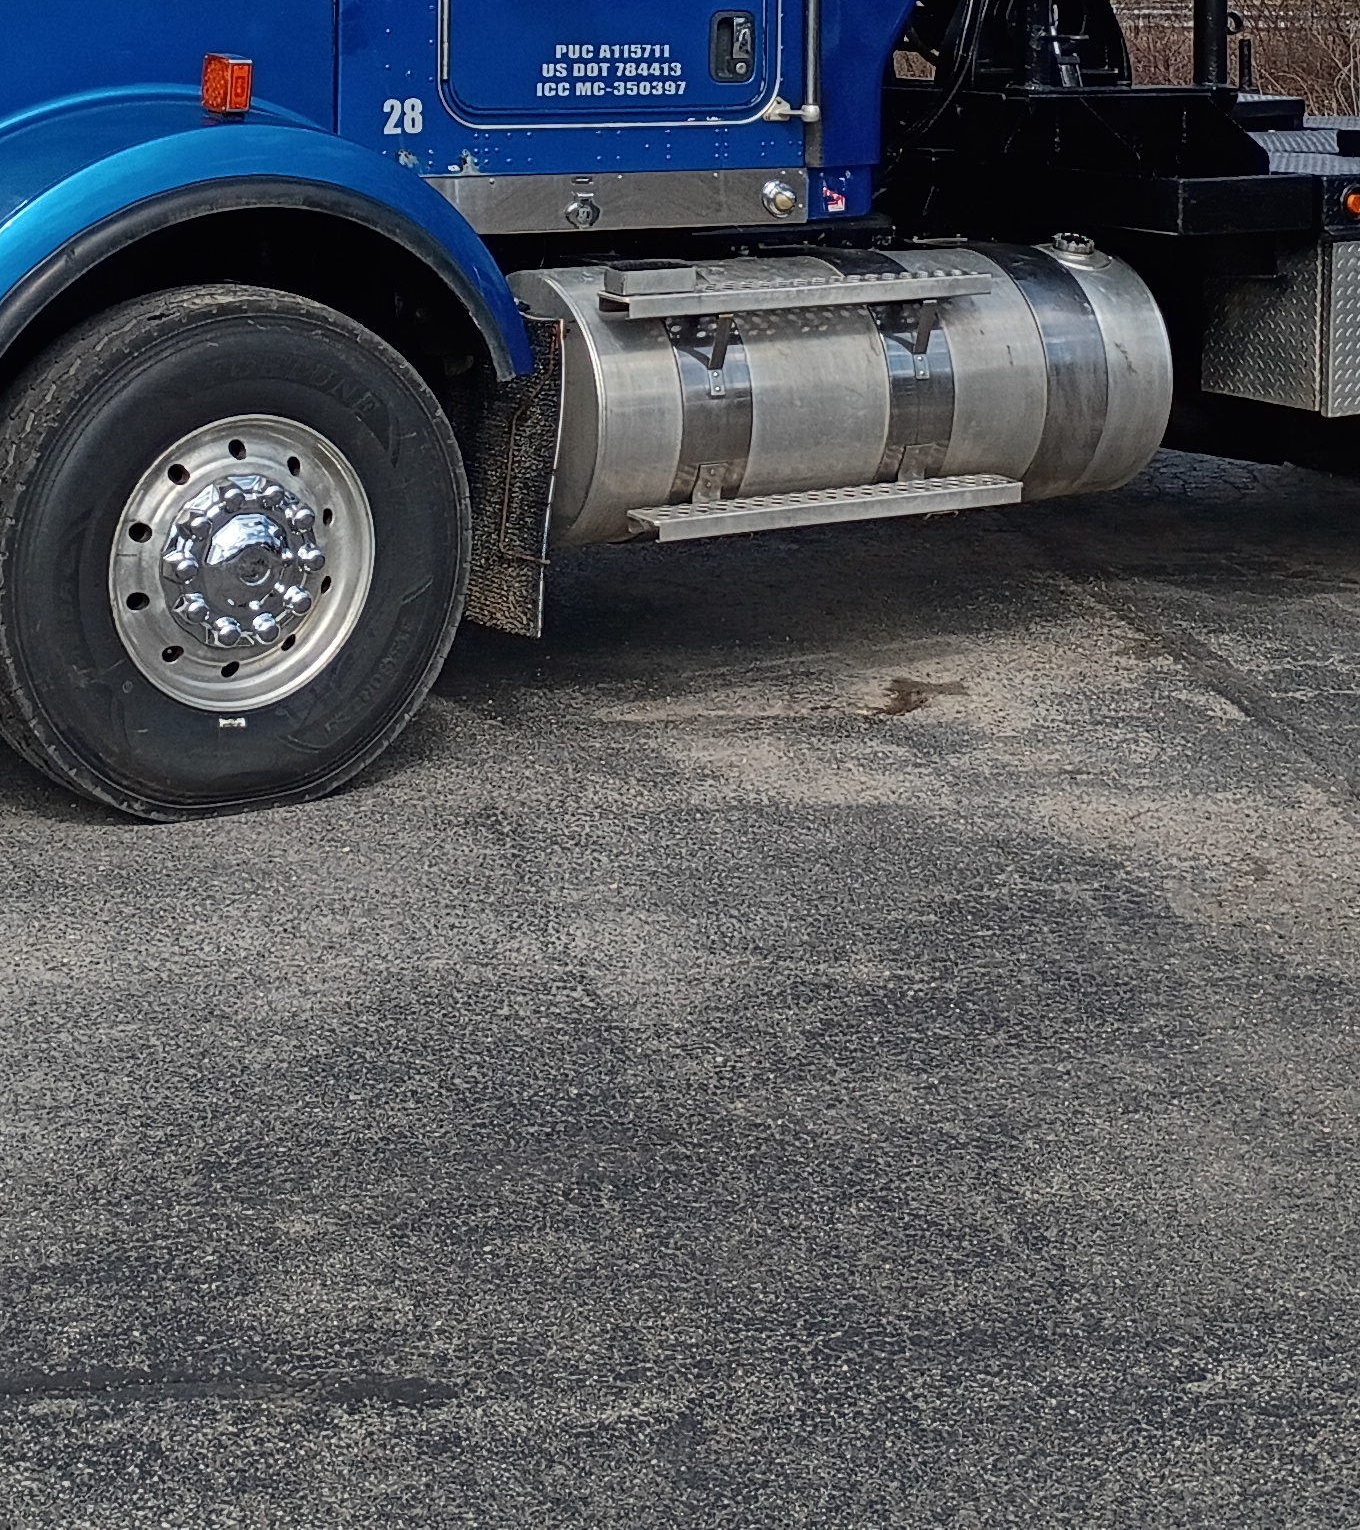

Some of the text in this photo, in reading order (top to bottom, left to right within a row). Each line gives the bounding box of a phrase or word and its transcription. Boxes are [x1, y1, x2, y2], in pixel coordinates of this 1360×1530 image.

[555, 44, 670, 59] PUC A115711
[542, 62, 682, 77] US DOT 784413
[536, 80, 687, 96] ICC MC-350397
[383, 97, 423, 135] 28
